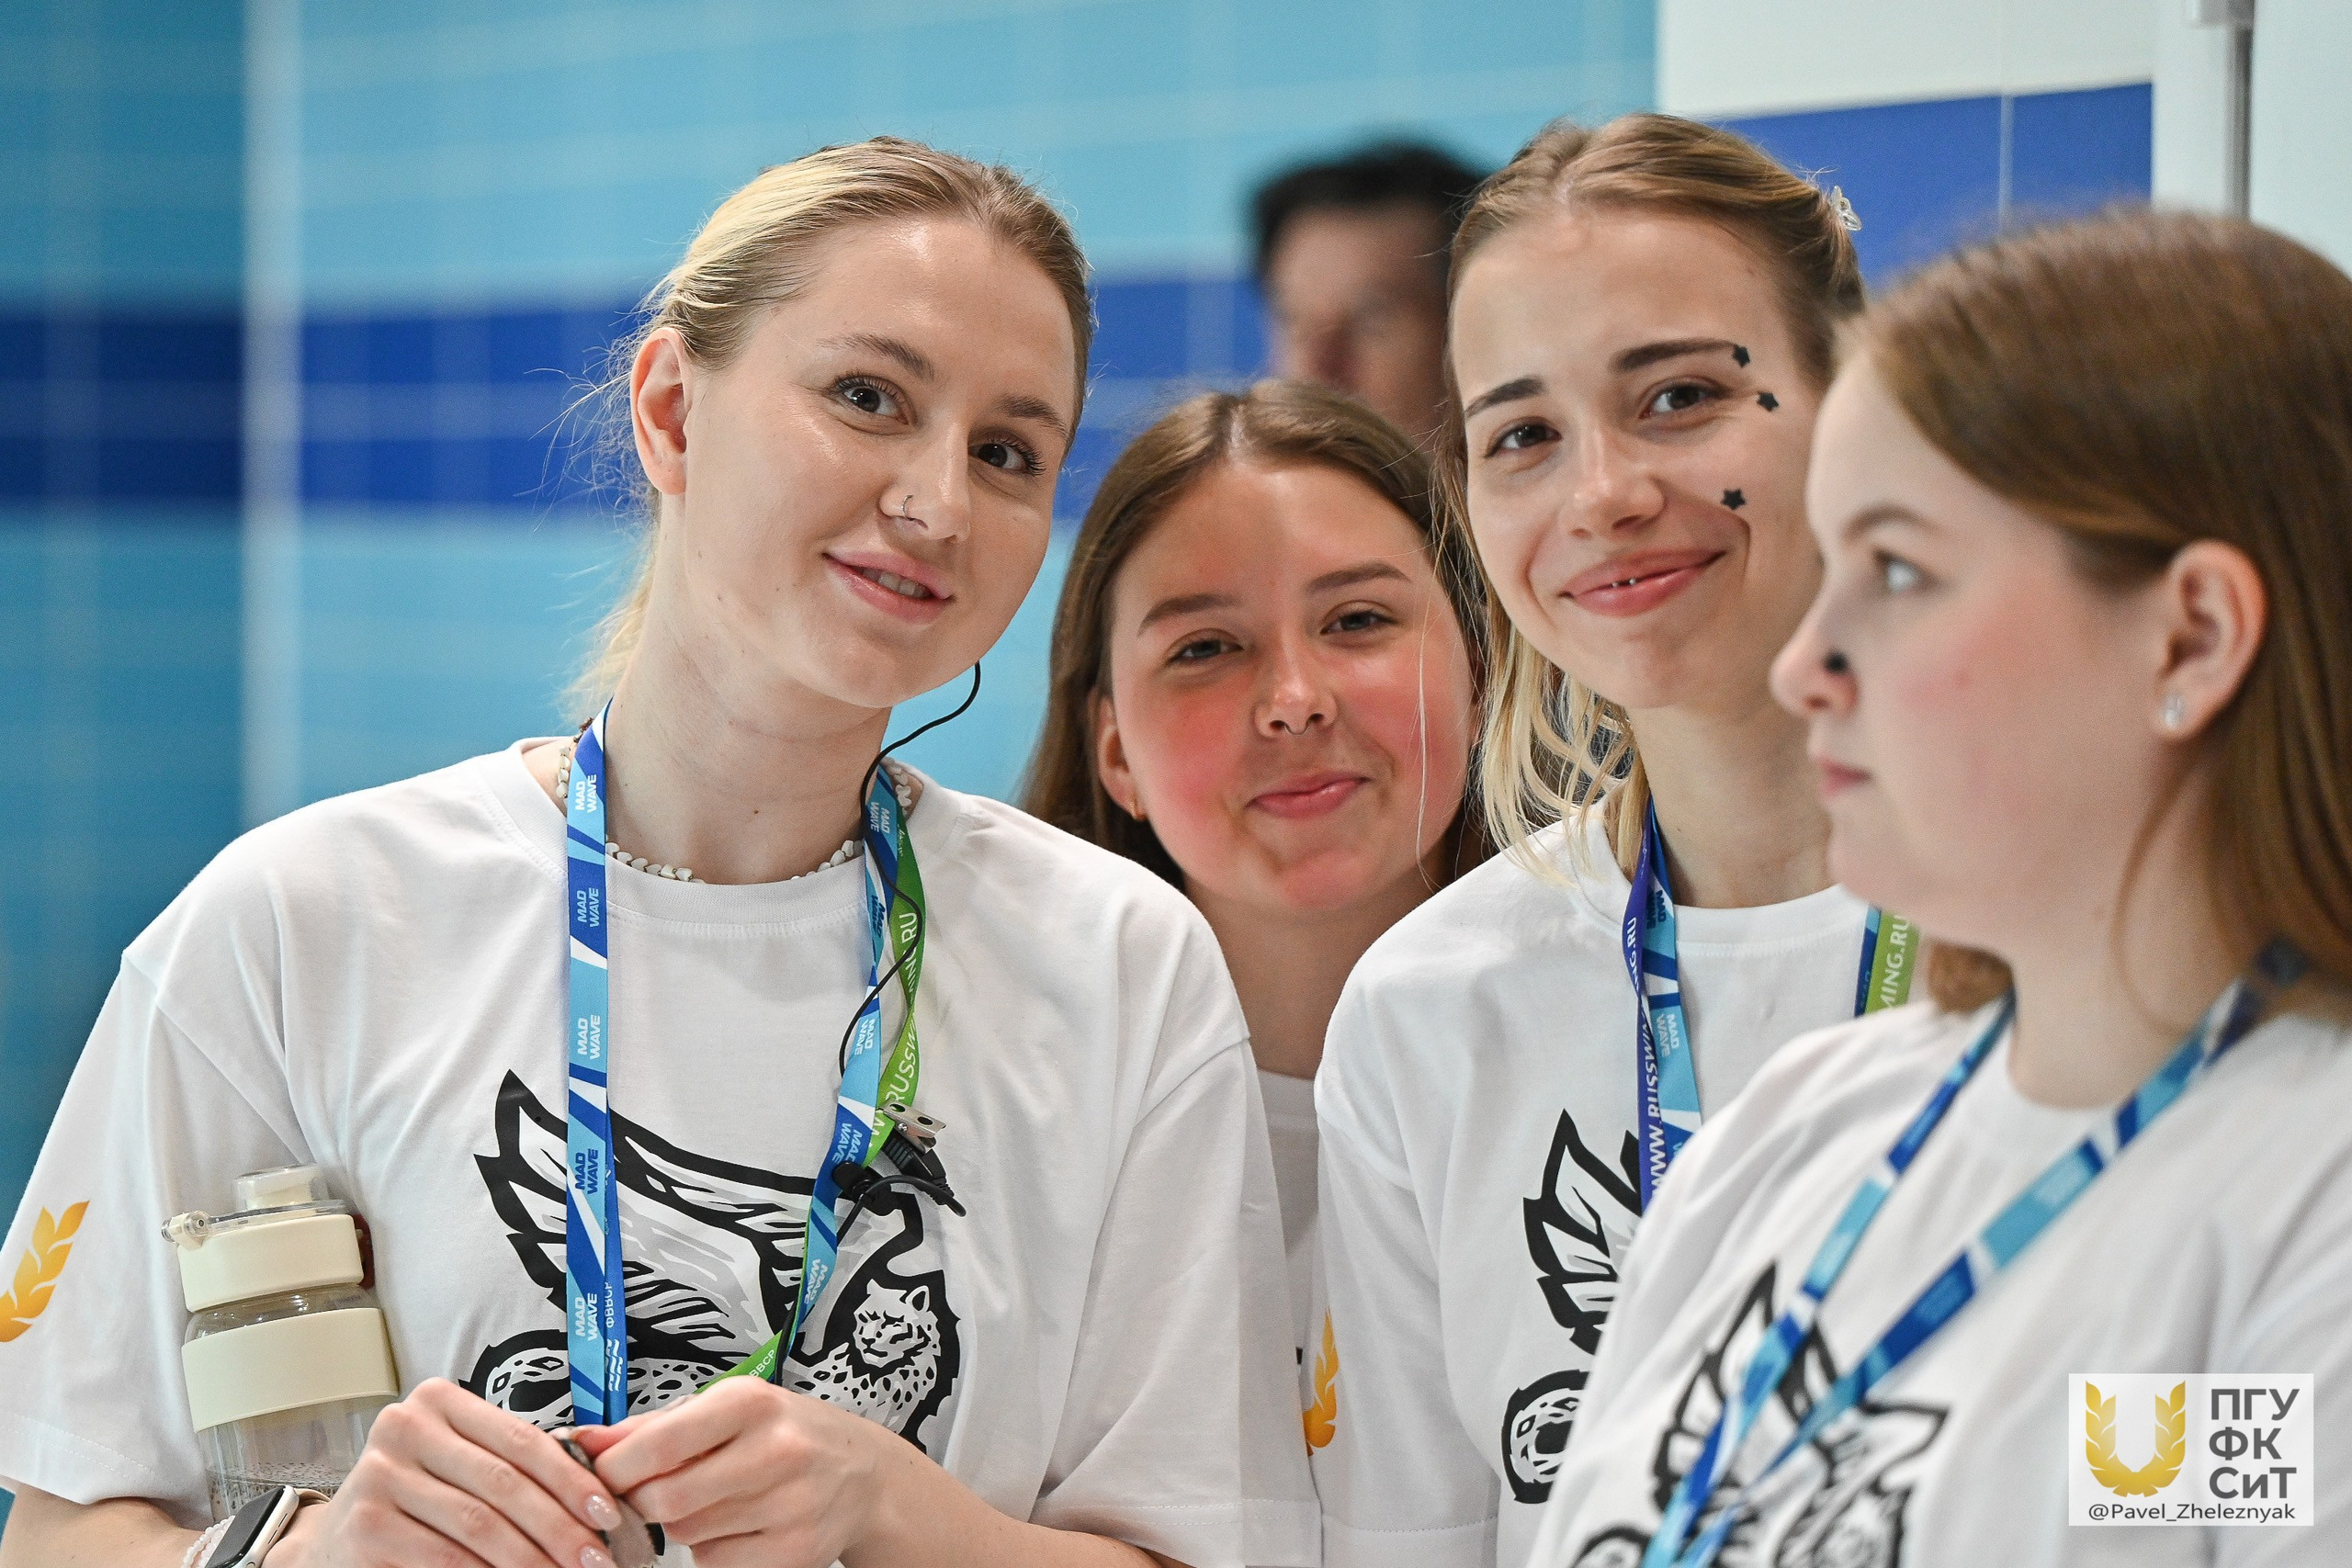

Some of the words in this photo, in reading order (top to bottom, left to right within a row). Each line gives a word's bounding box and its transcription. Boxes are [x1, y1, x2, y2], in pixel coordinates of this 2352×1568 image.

[575, 781, 586, 810] MAD
[587, 774, 597, 814] WAVE
[870, 802, 879, 832] WAVE
[881, 807, 890, 833] MAD
[577, 890, 587, 923] MAD
[589, 887, 599, 928] WAVE
[577, 1017, 588, 1056] MAD
[590, 1014, 601, 1060] WAVE
[865, 1018, 875, 1049] MAD
[1657, 1014, 1670, 1056] WAVE
[1667, 1013, 1679, 1049] MAD
[831, 1122, 852, 1164] WAVE
[575, 1152, 585, 1190] MAD
[587, 1148, 598, 1195] WAVE
[804, 1258, 821, 1304] WAVE
[810, 1263, 828, 1301] MAD
[575, 1297, 586, 1337] MAD
[587, 1292, 598, 1341] WAVE
